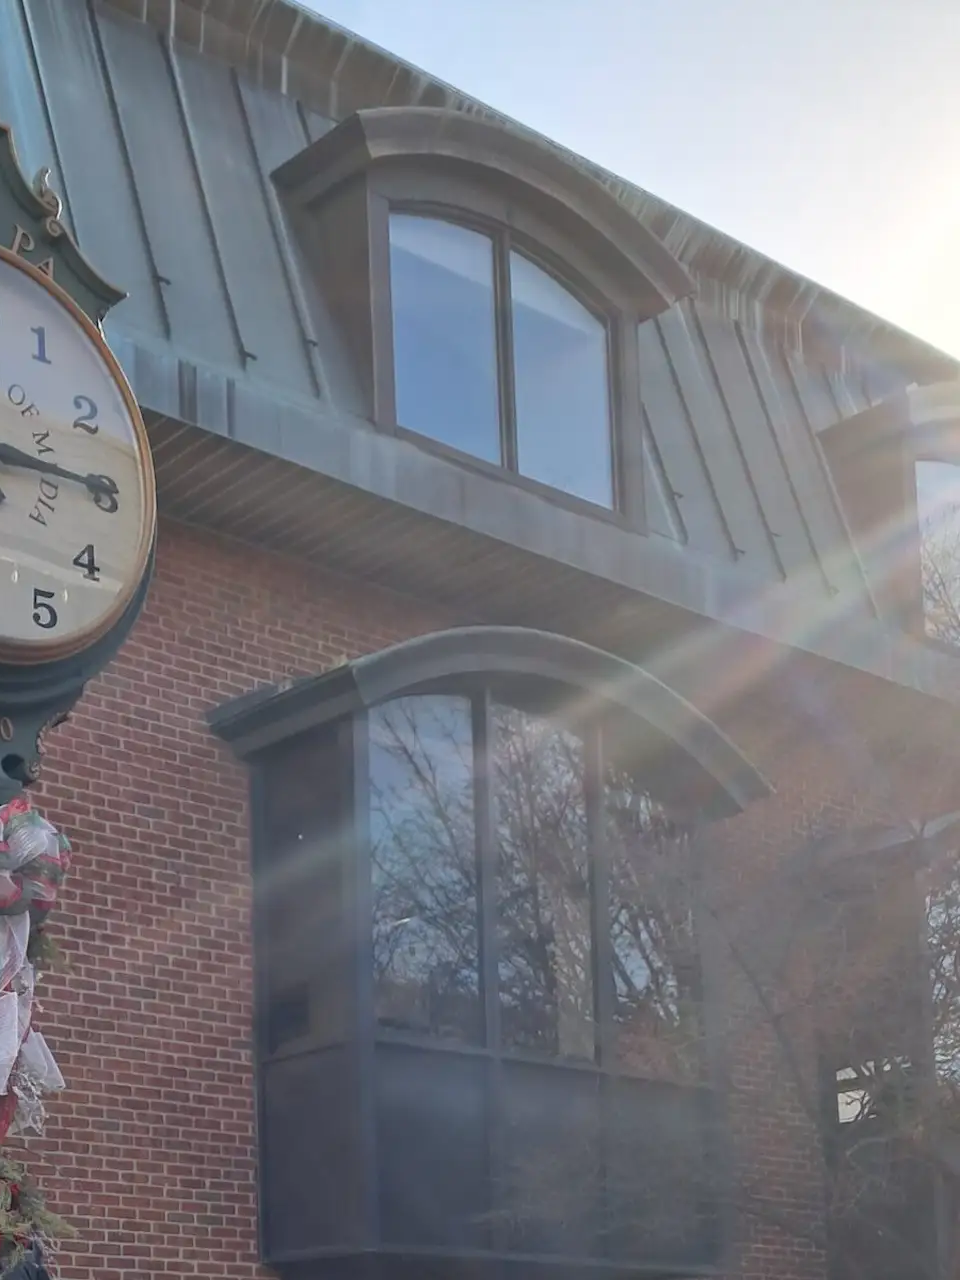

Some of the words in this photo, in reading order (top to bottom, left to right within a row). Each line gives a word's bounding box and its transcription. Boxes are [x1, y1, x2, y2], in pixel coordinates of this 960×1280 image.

[11, 223, 55, 279] PA
[30, 326, 52, 365] 1
[72, 395, 99, 435] 2
[7, 384, 40, 420] OF
[28, 430, 60, 527] MDIA
[72, 544, 100, 582] 4
[32, 587, 58, 629] 5
